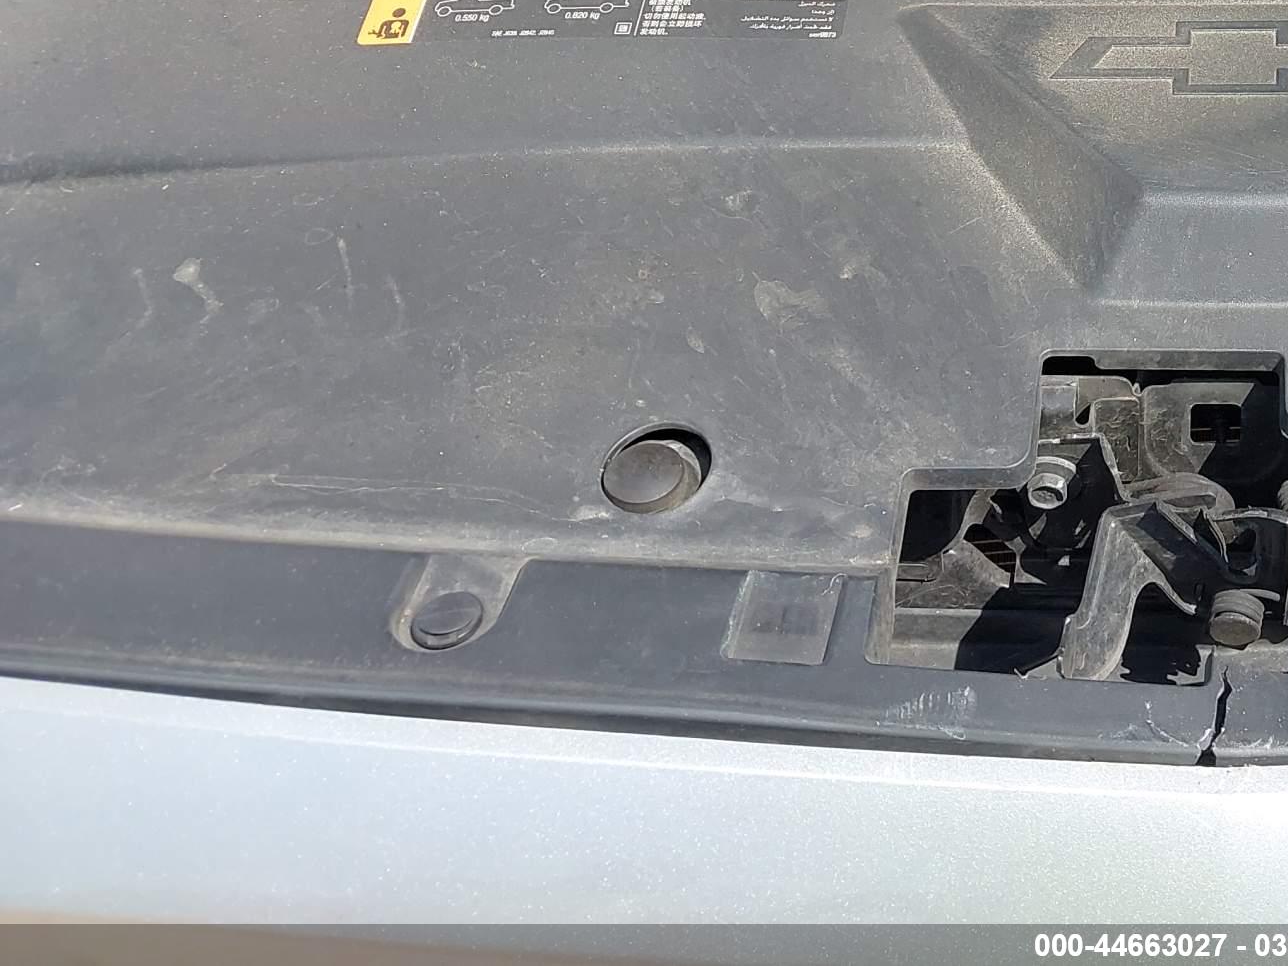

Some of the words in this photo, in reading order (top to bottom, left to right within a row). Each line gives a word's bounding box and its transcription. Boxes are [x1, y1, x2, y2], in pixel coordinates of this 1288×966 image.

[454, 13, 478, 23] 0.550
[478, 14, 490, 23] kg
[564, 11, 588, 20] 0.820
[588, 11, 600, 20] kg
